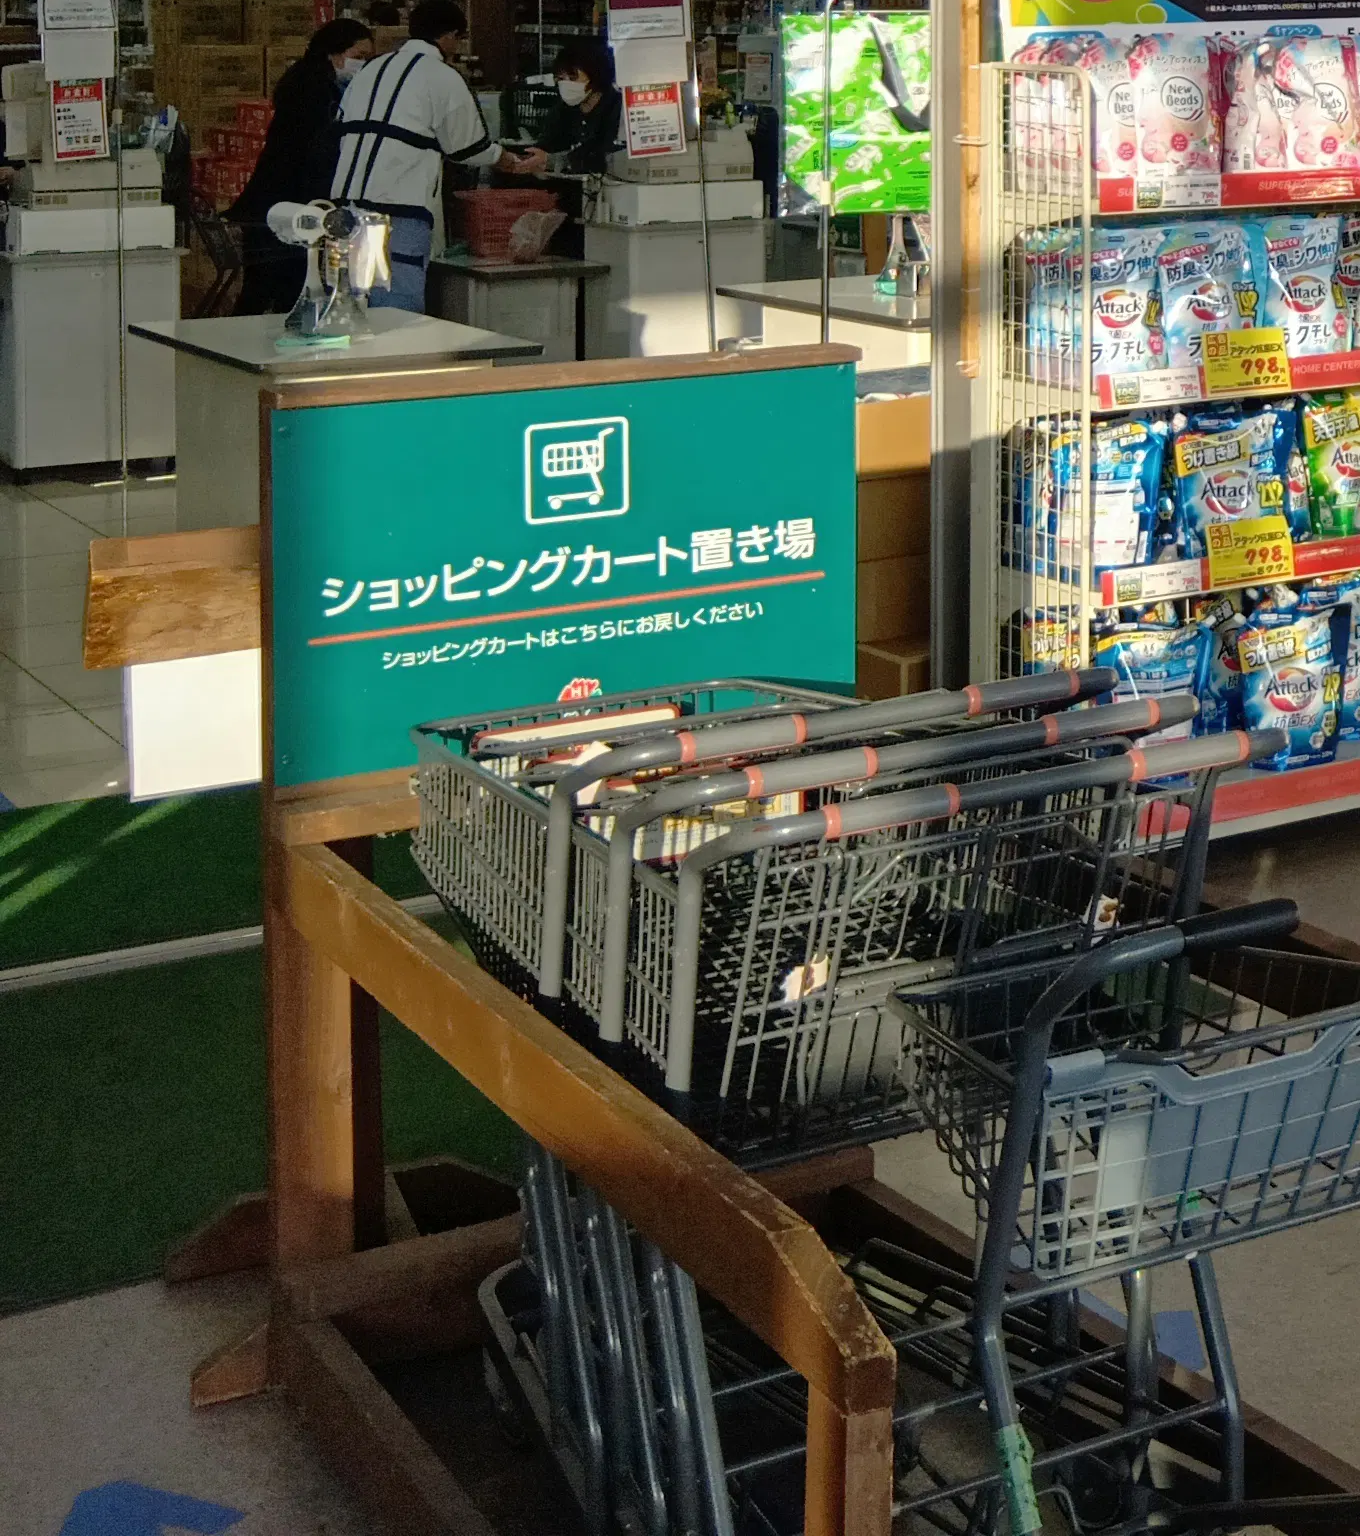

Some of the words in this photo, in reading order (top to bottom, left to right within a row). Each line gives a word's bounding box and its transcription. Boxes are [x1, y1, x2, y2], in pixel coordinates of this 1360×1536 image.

[1168, 83, 1194, 98] New
[1280, 283, 1327, 303] Attack
[1091, 295, 1143, 315] Attack
[1202, 477, 1255, 500] Attack
[320, 516, 817, 618] ショッピングカート置き場
[381, 600, 765, 671] ショッピングカートはこちらにお戻しください
[1264, 674, 1318, 695] Attack
